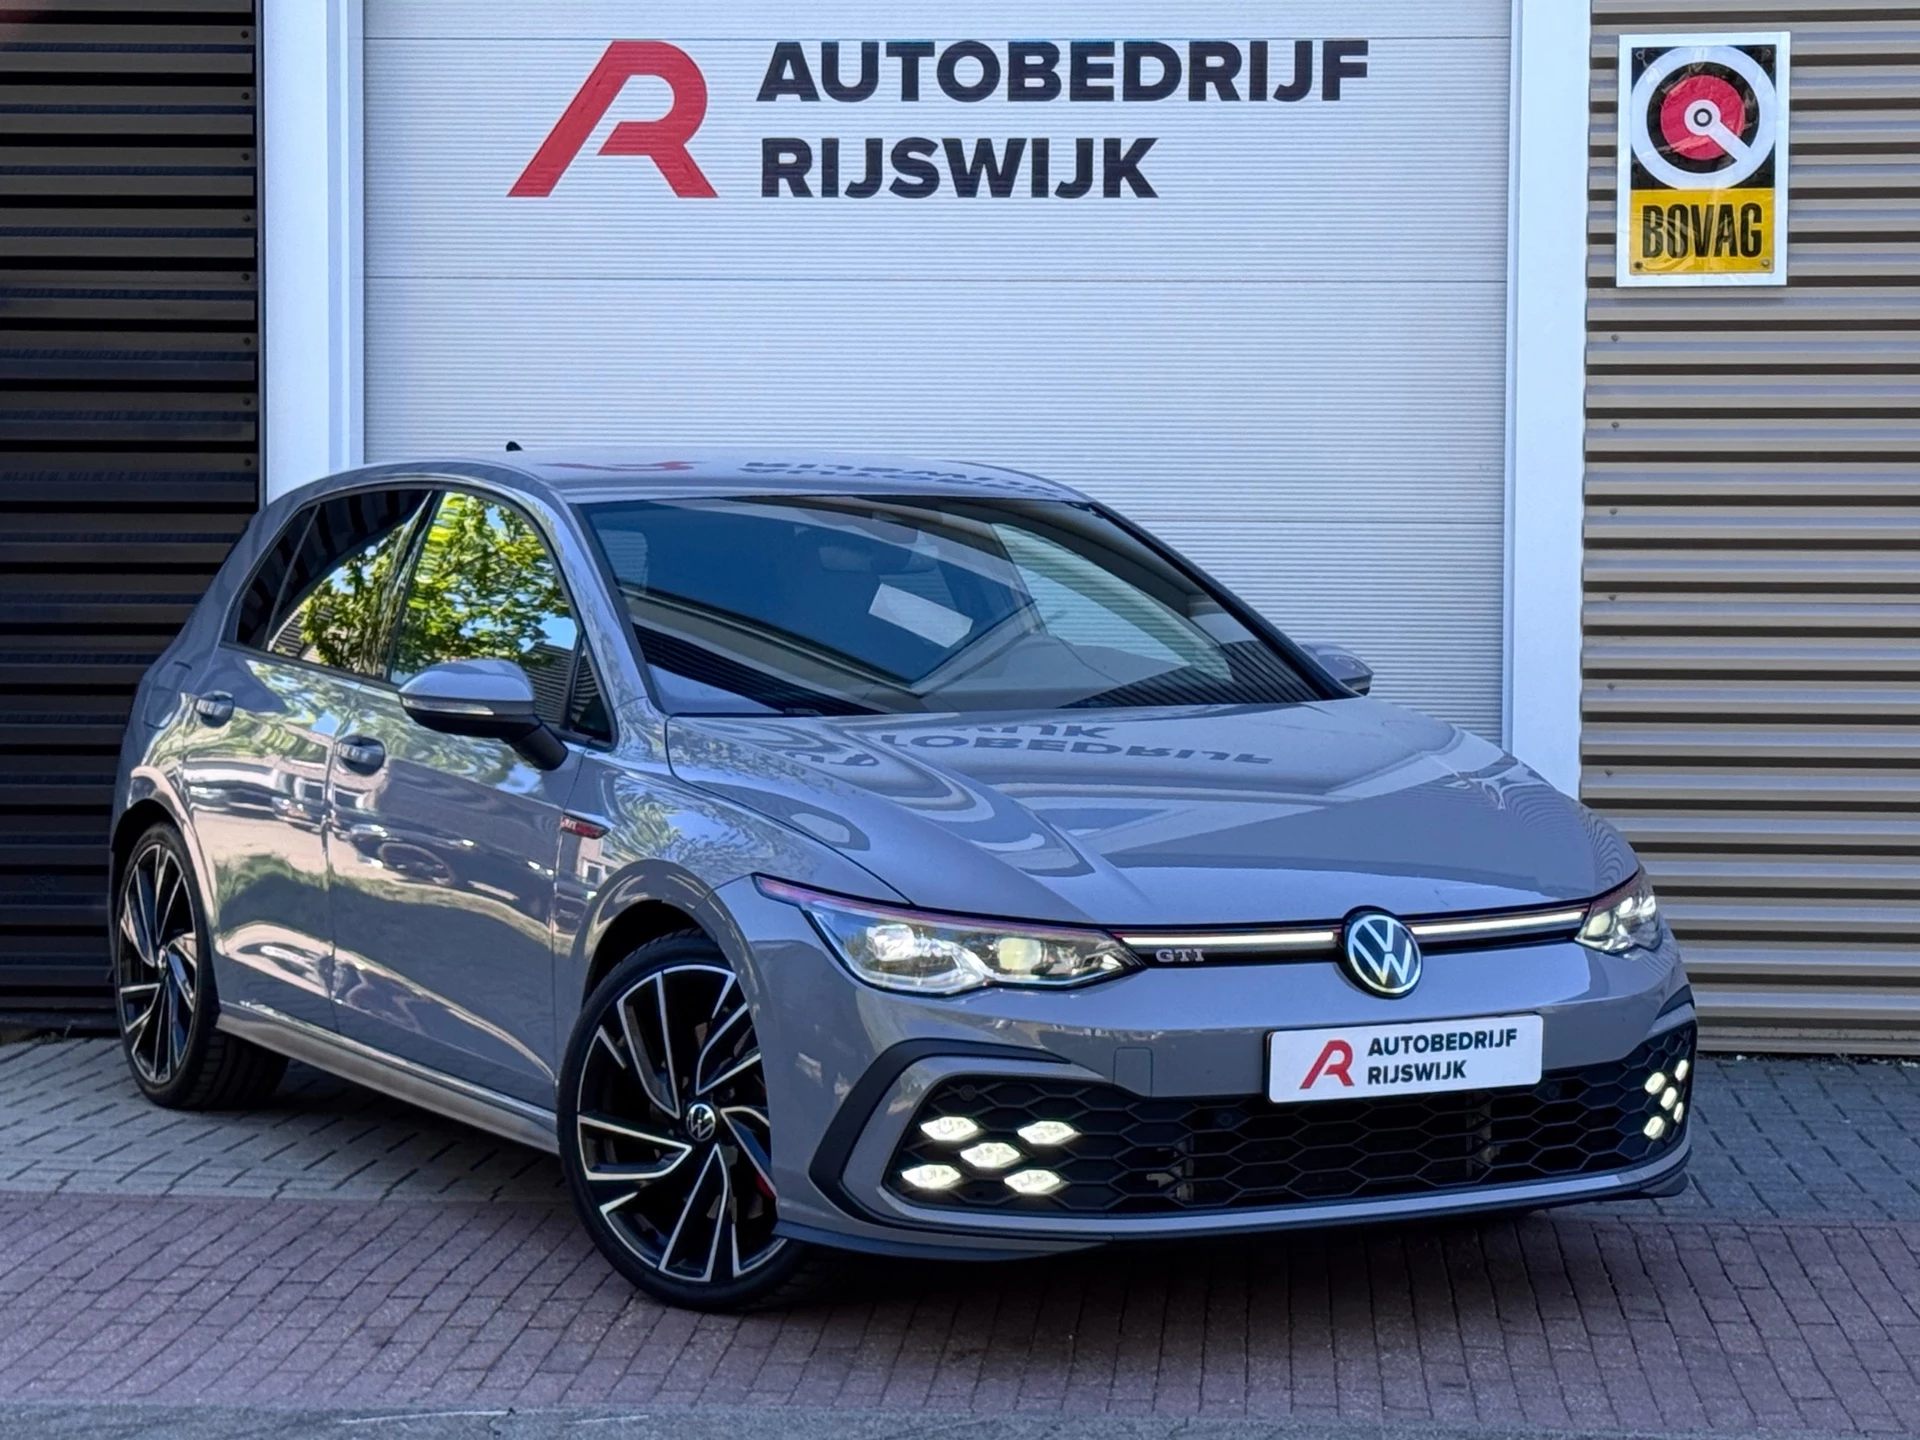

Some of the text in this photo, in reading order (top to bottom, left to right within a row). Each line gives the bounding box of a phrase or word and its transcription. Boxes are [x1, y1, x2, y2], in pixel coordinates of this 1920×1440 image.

[757, 40, 1369, 103] AUTOBEDRIJF
[761, 137, 1158, 199] RIJSWIJK
[1642, 202, 1763, 259] BOVAG
[1155, 948, 1205, 963] GTI
[1367, 1028, 1518, 1057] AUTOBEDRIJF
[1367, 1060, 1467, 1085] RIJSWIJK
